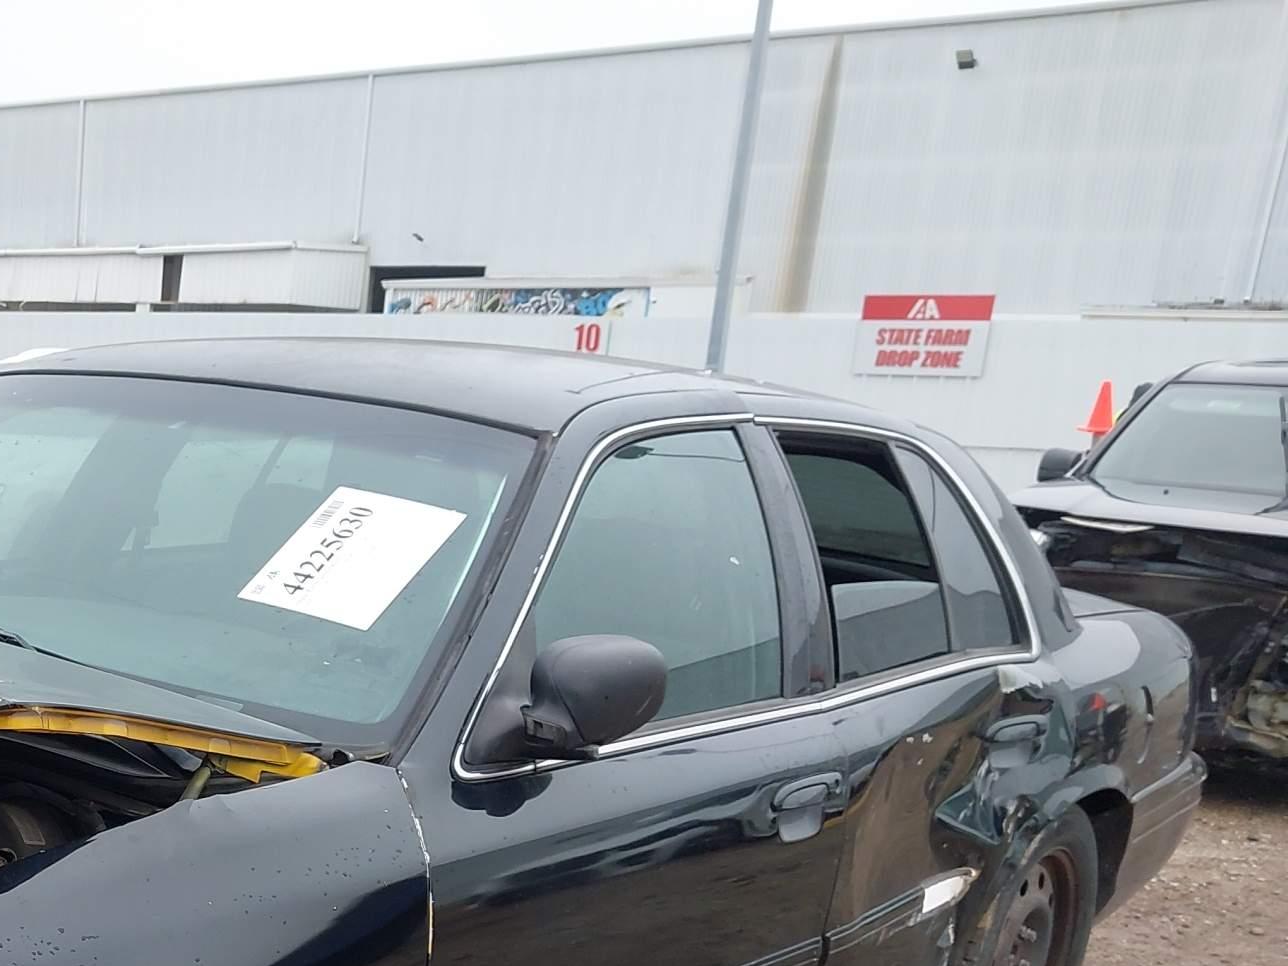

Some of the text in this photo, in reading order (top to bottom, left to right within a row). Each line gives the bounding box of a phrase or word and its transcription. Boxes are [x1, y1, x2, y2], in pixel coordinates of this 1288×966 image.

[575, 323, 601, 352] 10
[875, 328, 972, 346] STATE FARM
[874, 350, 964, 368] DROP ZONE
[283, 506, 373, 595] 44225630
